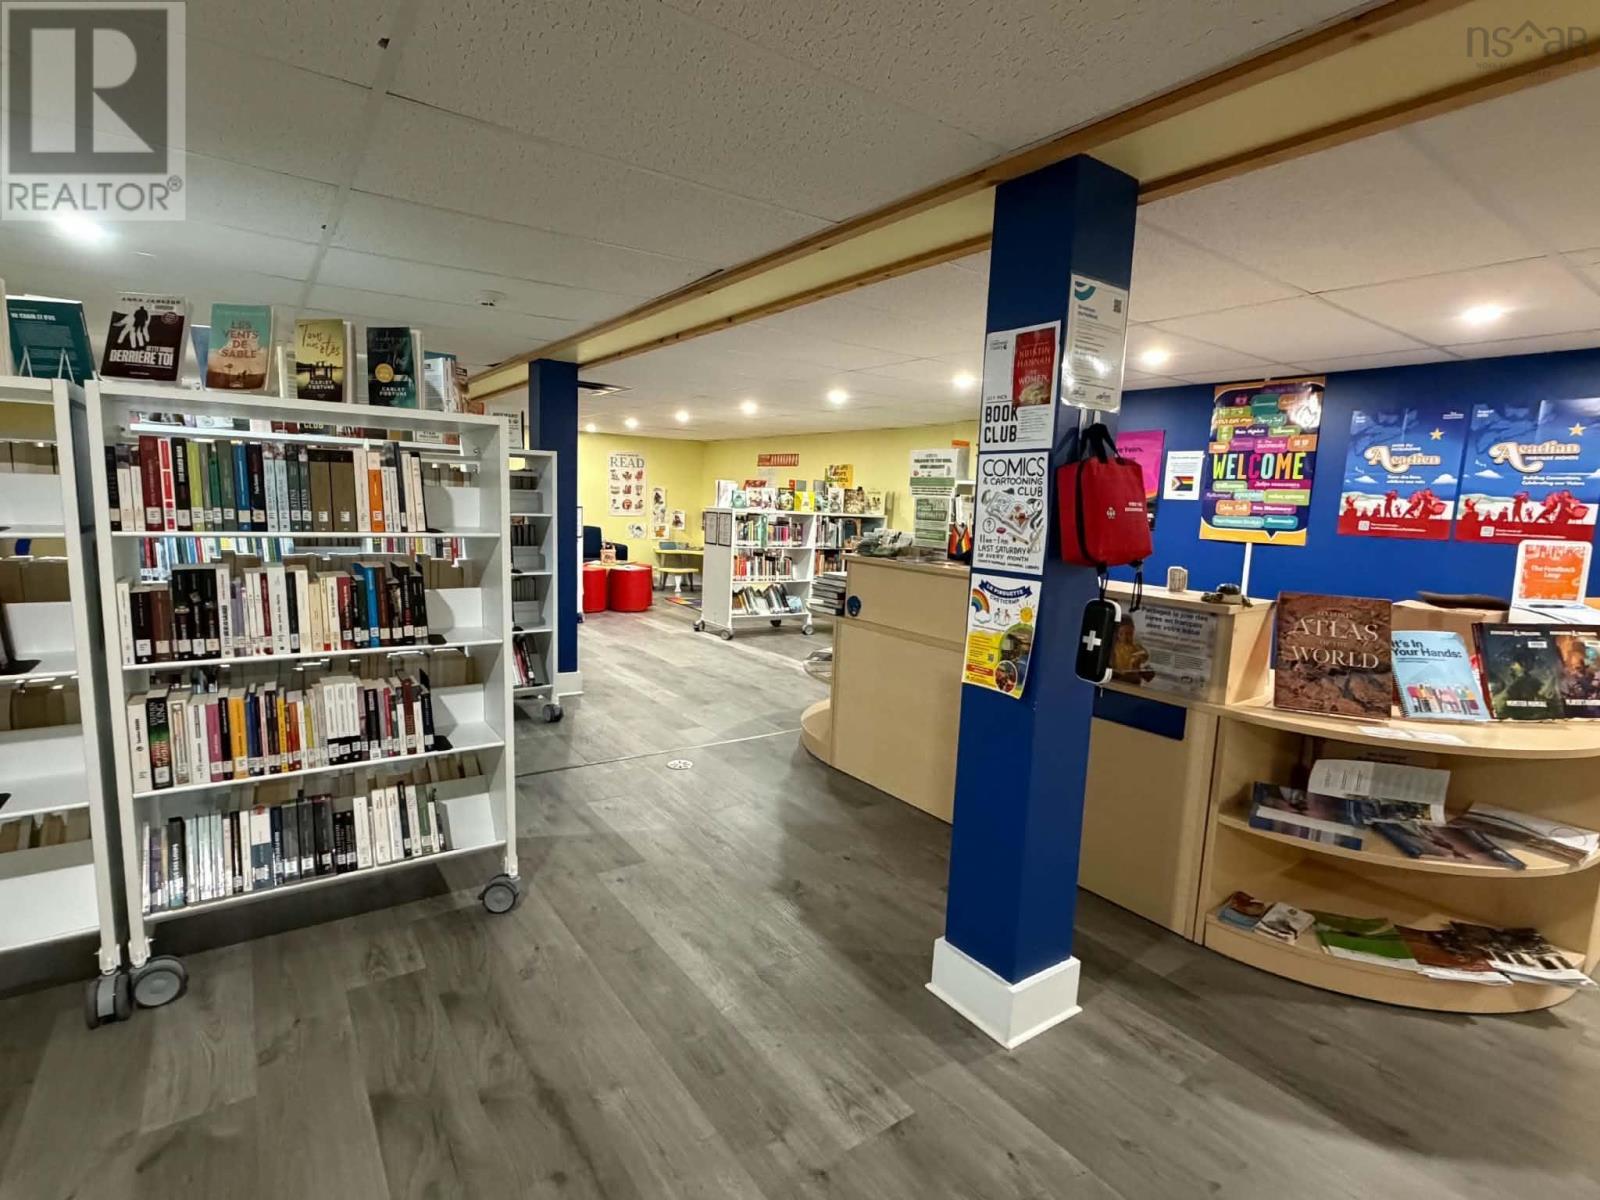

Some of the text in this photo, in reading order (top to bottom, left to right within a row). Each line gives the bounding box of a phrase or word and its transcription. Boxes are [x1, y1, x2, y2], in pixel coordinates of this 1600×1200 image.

[224, 329, 260, 341] VENTS
[232, 340, 249, 350] DE
[158, 352, 174, 366] TOI
[221, 348, 257, 361] SABLE
[985, 404, 1018, 423] BOOK
[984, 425, 1018, 444] CLUB
[609, 456, 645, 468] READ
[982, 457, 1045, 477] COMICS
[1212, 452, 1307, 480] WELCOME
[990, 476, 1043, 486] CARTOONING
[1017, 486, 1043, 497] CLUB
[978, 544, 1026, 555] LAST SATURDAY
[1286, 617, 1379, 641] ATLAS
[1392, 639, 1424, 648] It's In
[1291, 645, 1380, 669] WORLD
[1391, 648, 1419, 656] Your
